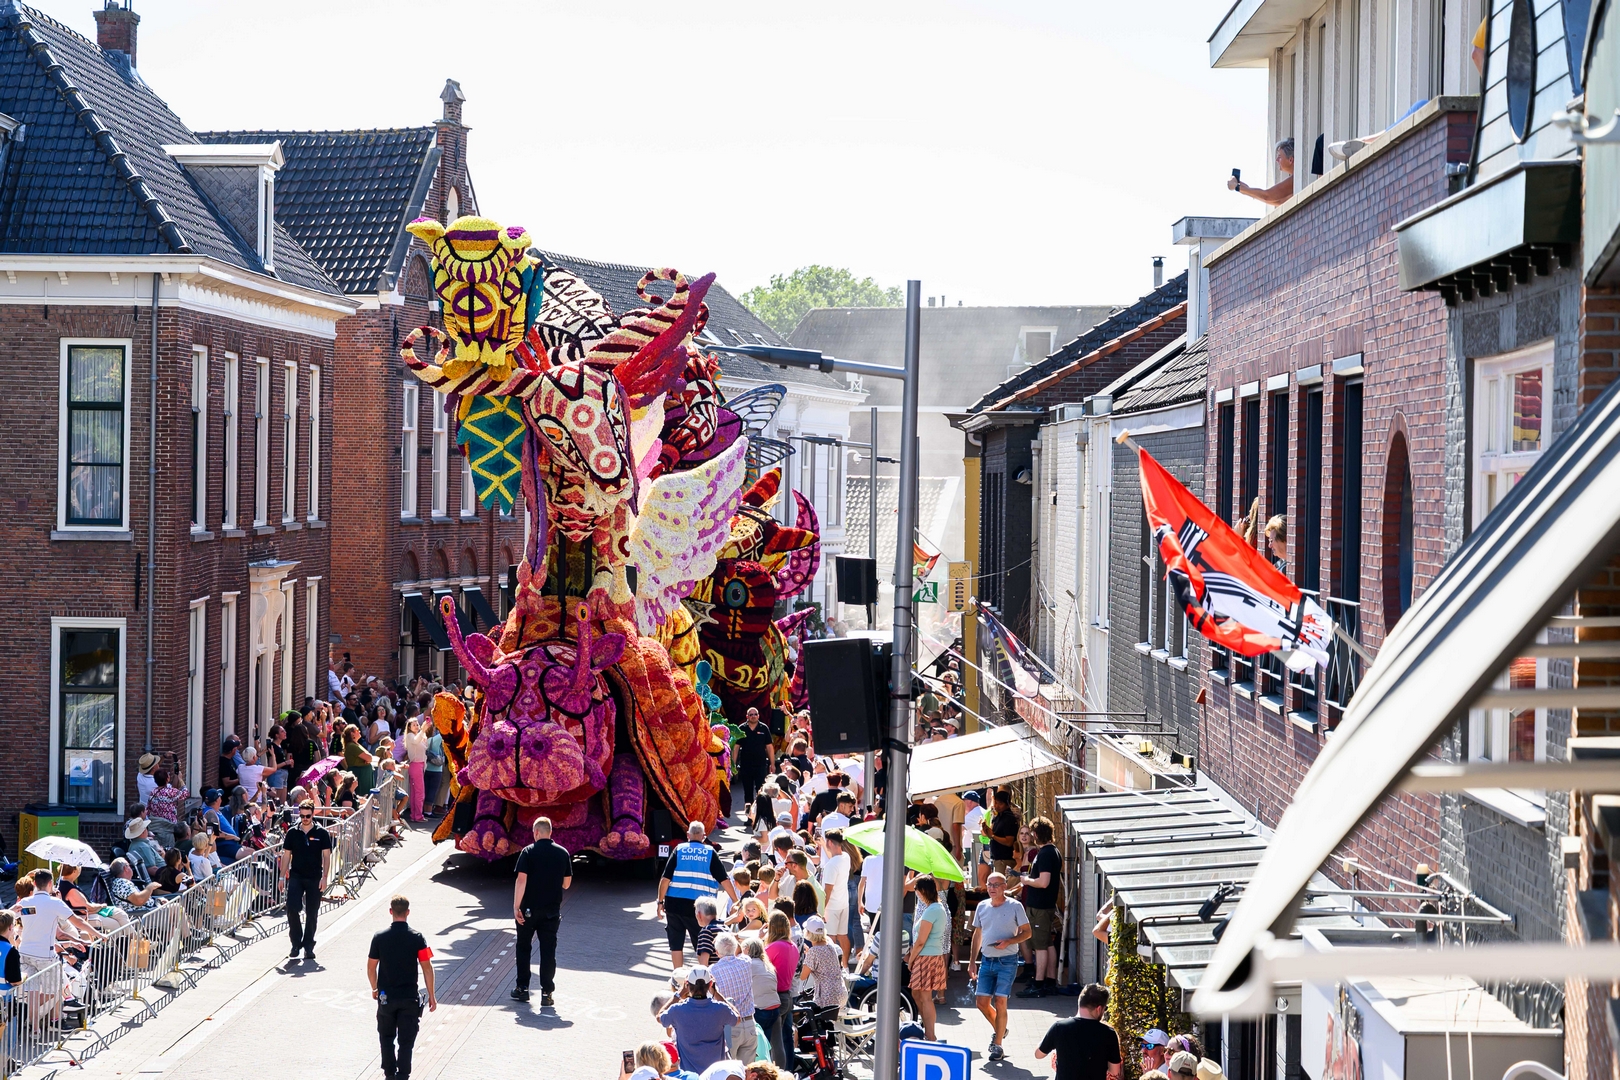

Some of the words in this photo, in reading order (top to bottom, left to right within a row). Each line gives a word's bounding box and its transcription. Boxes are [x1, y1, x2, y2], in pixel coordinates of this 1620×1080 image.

[660, 846, 669, 854] 10
[681, 846, 709, 855] corso
[681, 854, 708, 863] zundert
[917, 1053, 951, 1080] P
